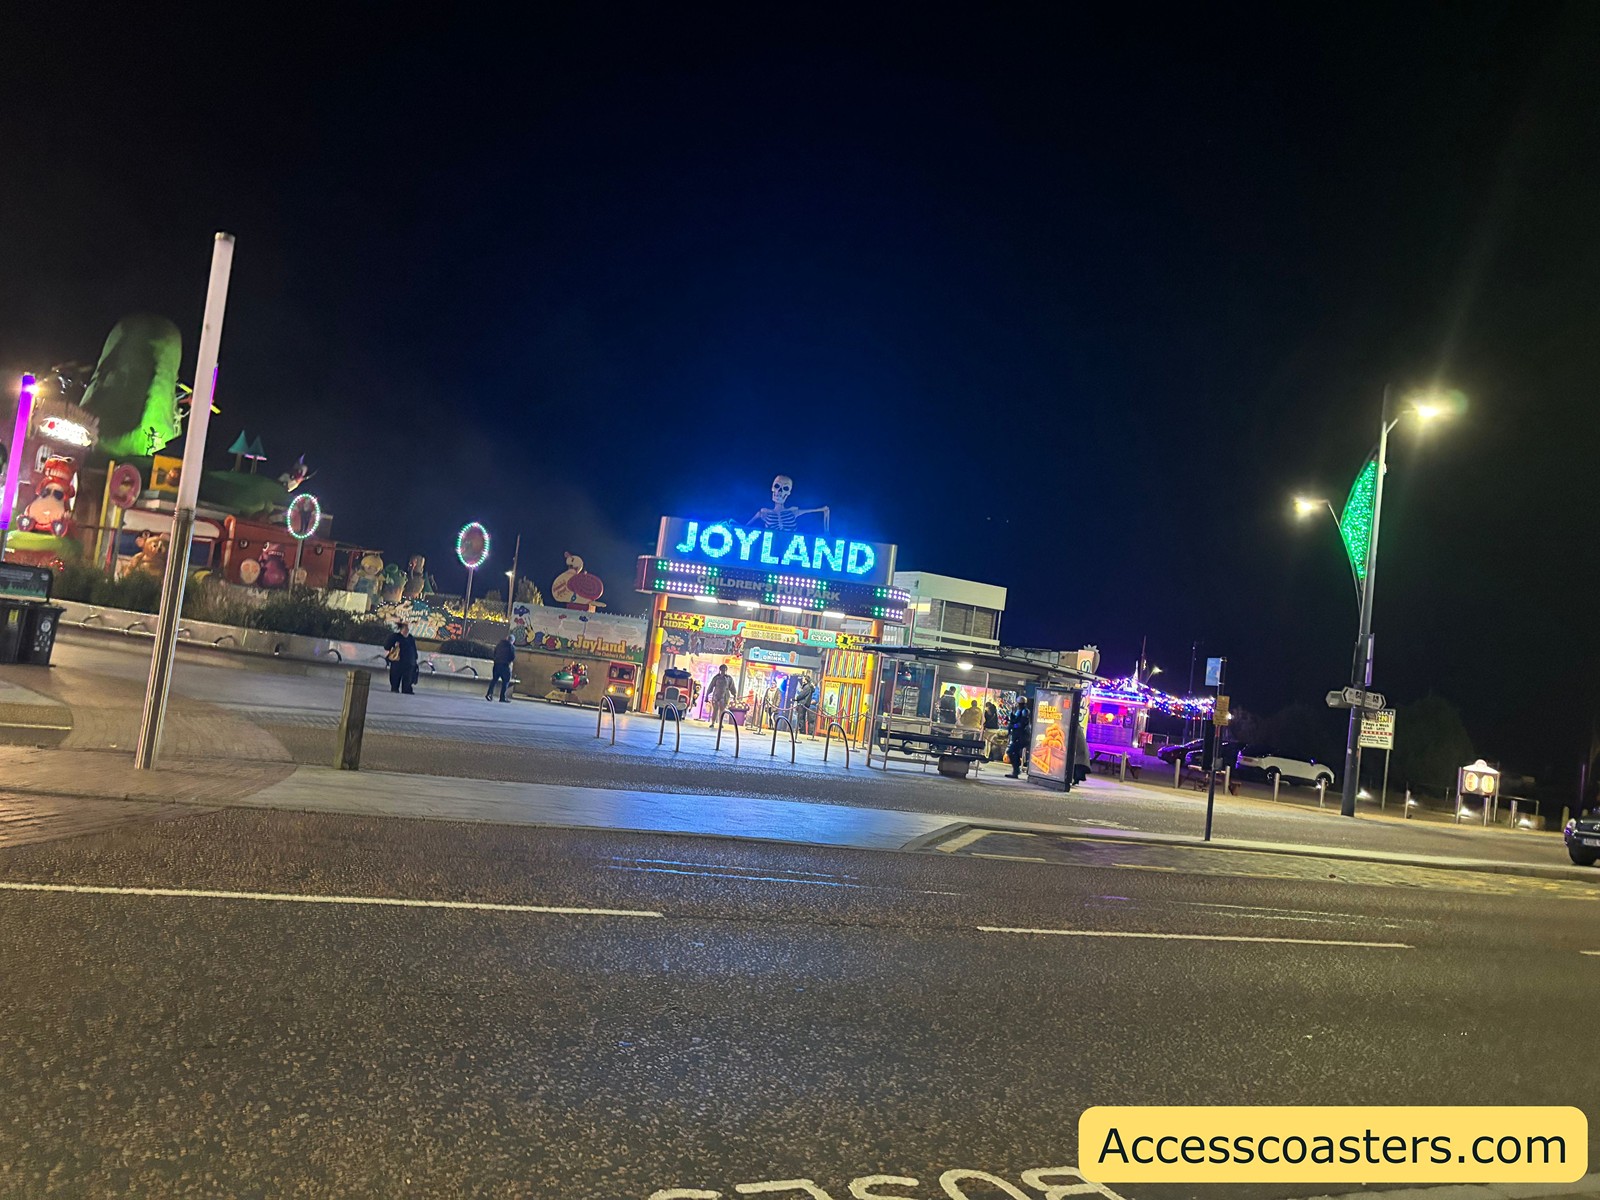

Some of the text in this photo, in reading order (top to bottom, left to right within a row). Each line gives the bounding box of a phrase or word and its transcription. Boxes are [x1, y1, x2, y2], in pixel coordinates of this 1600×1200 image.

[676, 522, 874, 574] JOYLAND
[697, 575, 841, 601] CHILDREN'S FUN PARK
[664, 612, 690, 621] ALL
[662, 620, 689, 630] RIDES
[708, 622, 730, 630] £3.00
[811, 634, 833, 643] £3.00
[573, 634, 627, 654] Joyland
